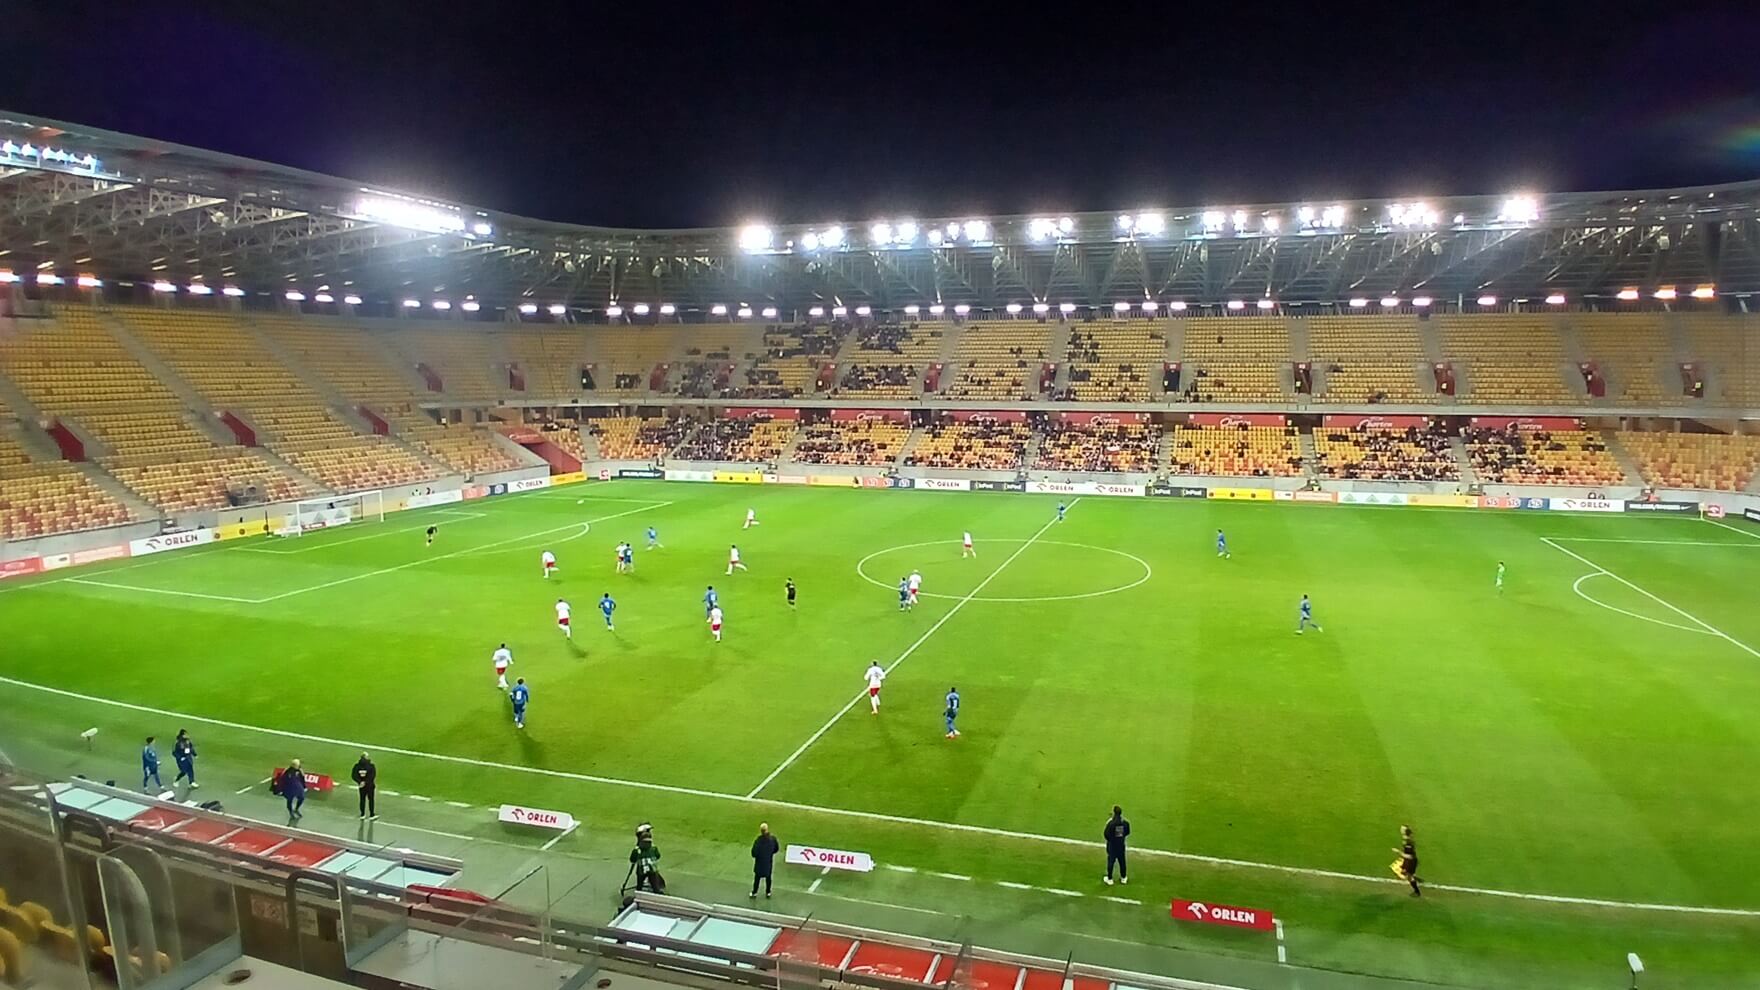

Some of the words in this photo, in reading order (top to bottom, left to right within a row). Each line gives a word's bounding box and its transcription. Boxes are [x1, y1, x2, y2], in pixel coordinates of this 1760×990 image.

[1579, 501, 1611, 509] ORLEN
[164, 534, 198, 546] ORLEN
[527, 812, 557, 824] ORLEN
[819, 852, 855, 865] ORLEN
[1211, 907, 1255, 924] ORLEN
